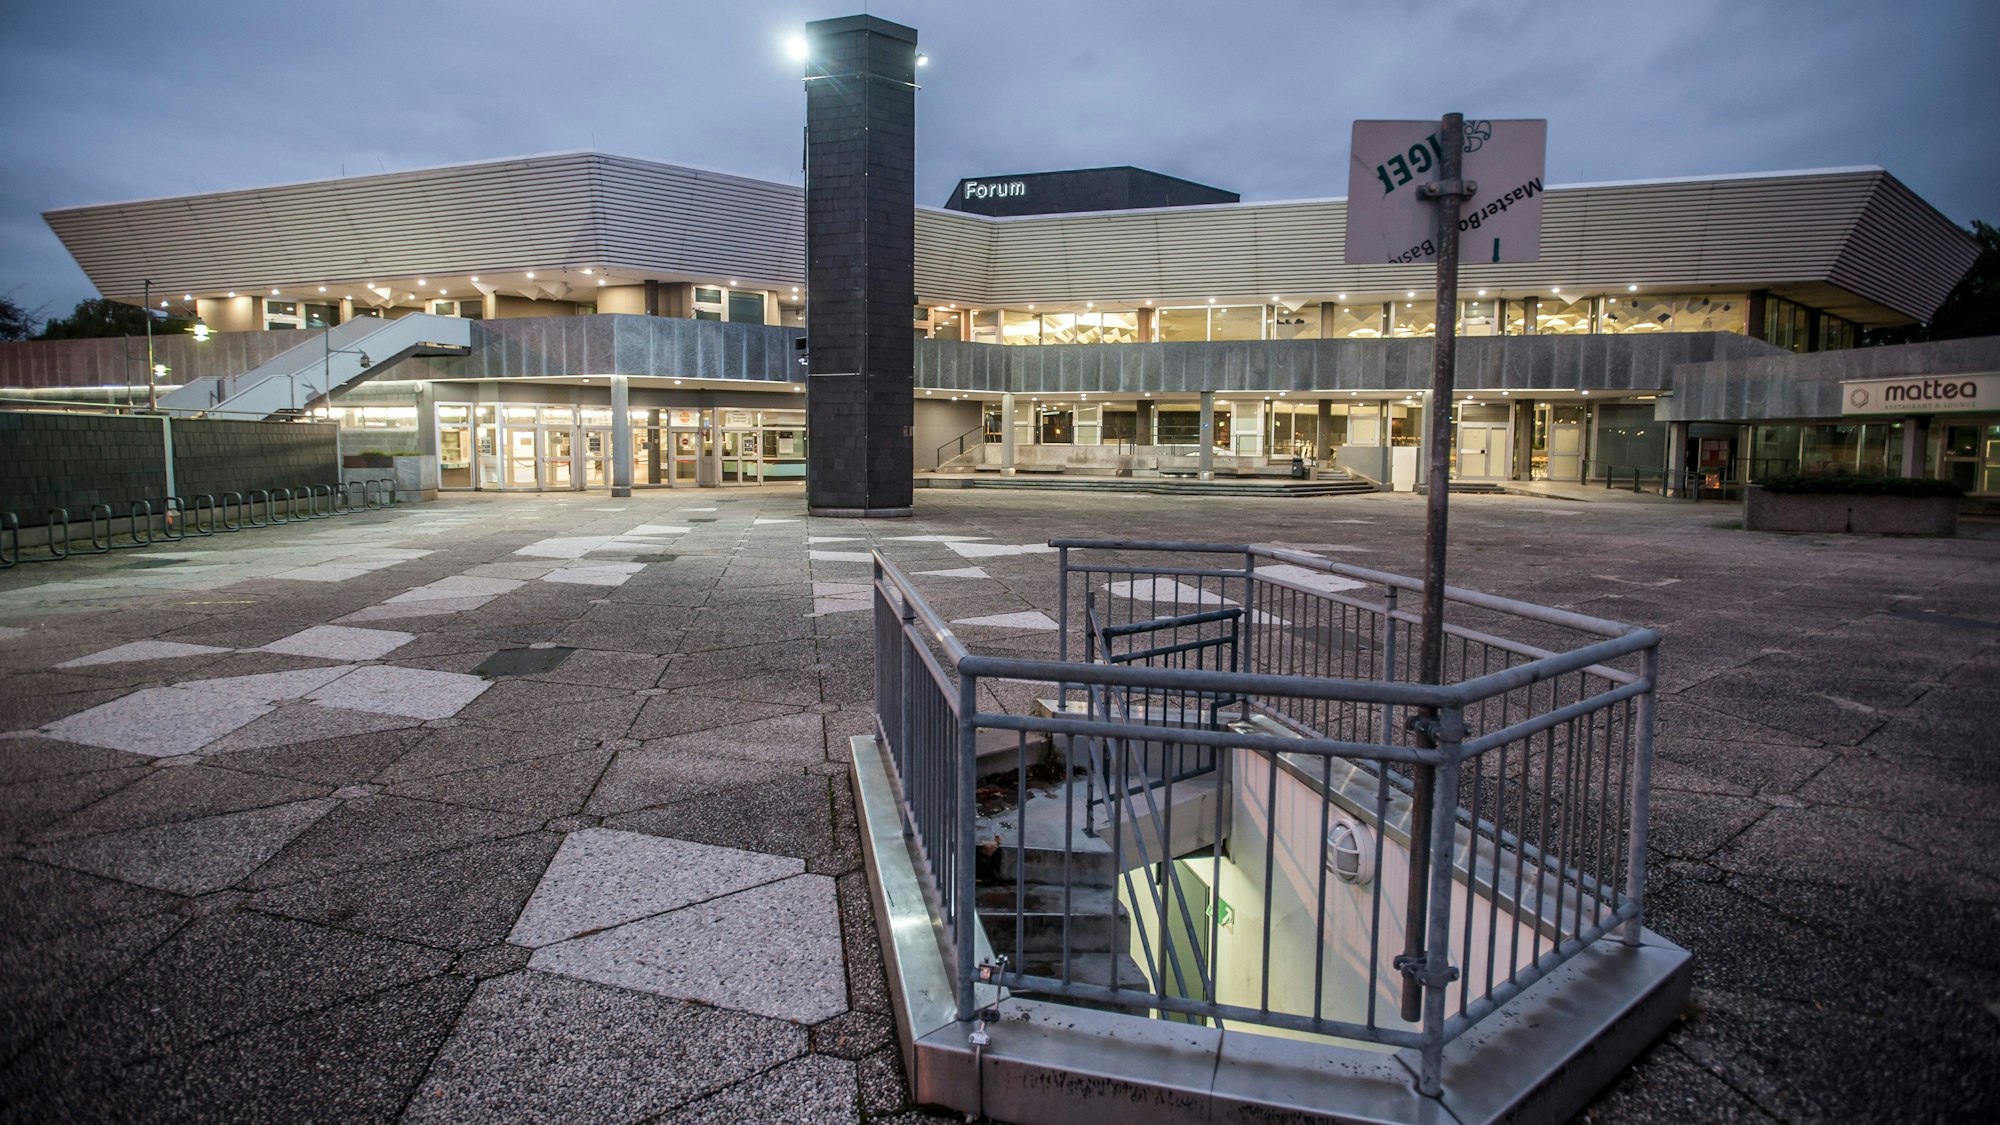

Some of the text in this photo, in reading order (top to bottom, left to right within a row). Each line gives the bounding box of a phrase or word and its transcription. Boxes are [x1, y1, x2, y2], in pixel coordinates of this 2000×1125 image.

[965, 181, 1025, 199] Forum
[1886, 380, 1977, 401] mattea
[1944, 401, 1976, 409] LOUNGE
